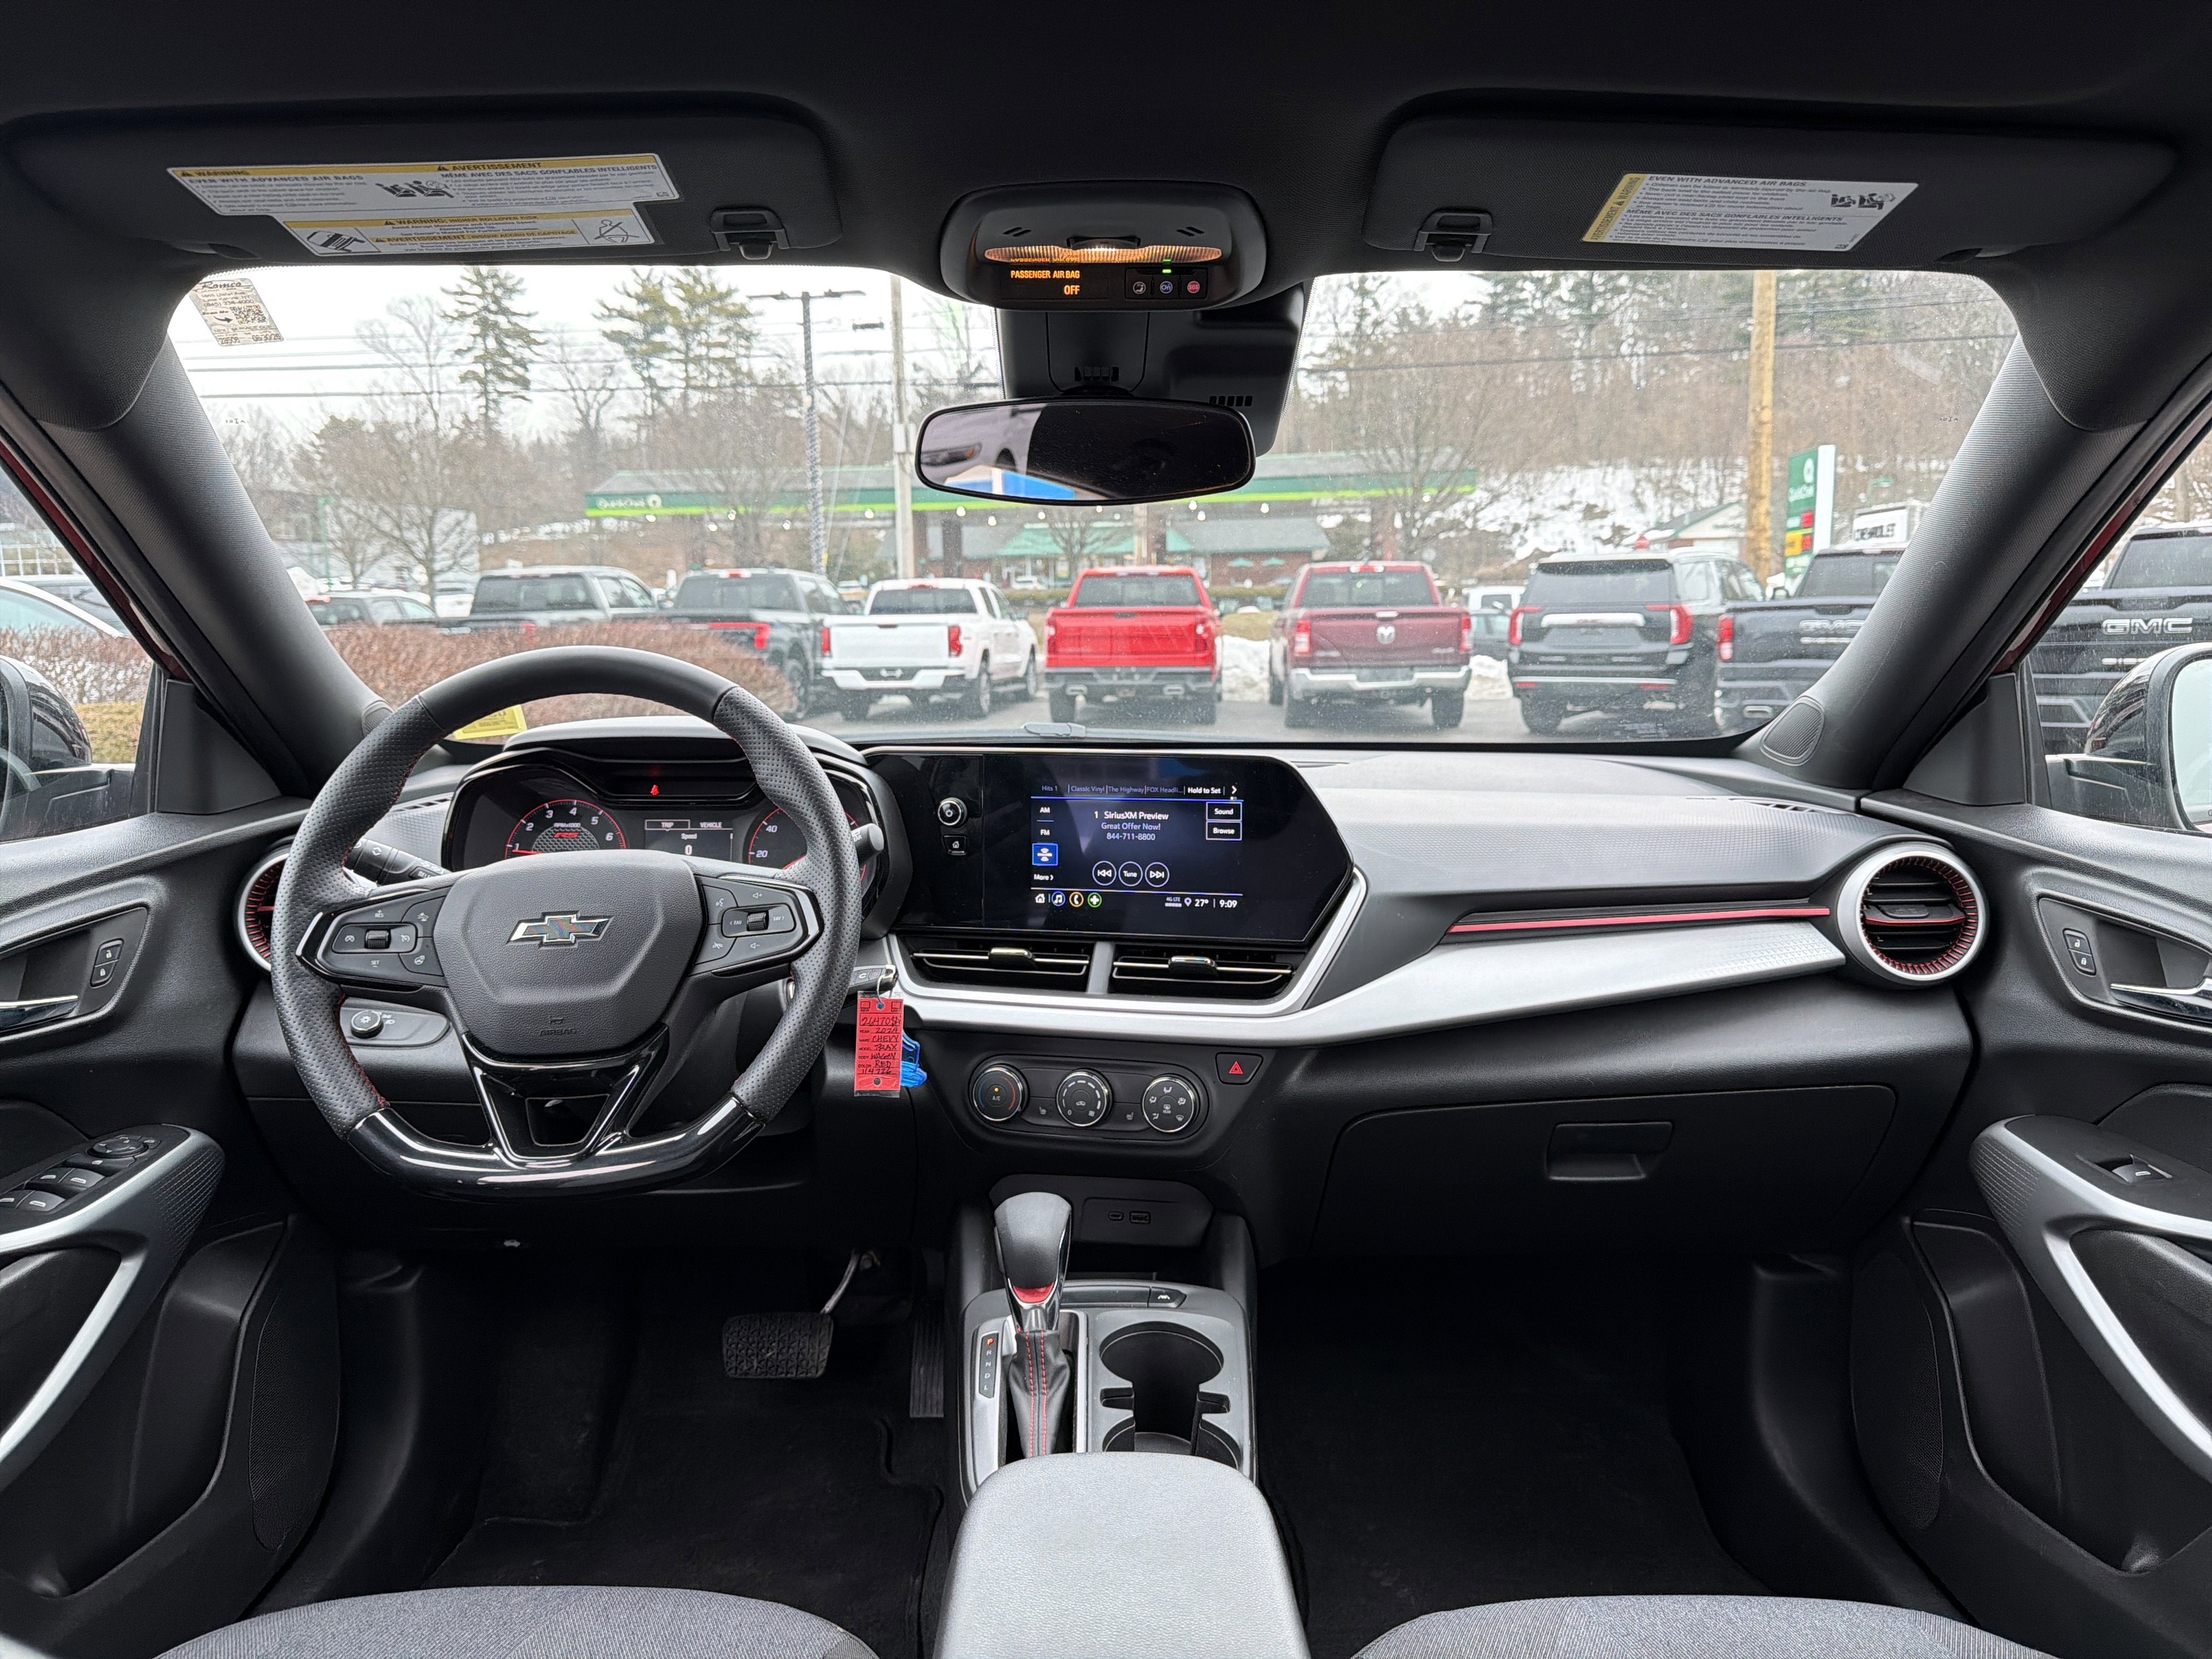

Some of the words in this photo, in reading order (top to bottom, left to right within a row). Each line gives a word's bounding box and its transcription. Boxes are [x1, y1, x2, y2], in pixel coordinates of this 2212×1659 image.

[453, 162, 541, 171] AVERTISSEMENT
[1616, 177, 1641, 200] WARNING
[1590, 206, 1621, 240] AVERTISSEMENT
[1011, 270, 1051, 279] PASSENGER
[1053, 270, 1065, 279] AIR
[1065, 270, 1080, 279] BAG
[1063, 285, 1080, 295] OFF
[2102, 617, 2193, 635] GMC
[545, 810, 554, 819] 3
[569, 807, 577, 816] 4
[1104, 811, 1137, 820] SiriusXM
[1138, 812, 1169, 820] Preview
[591, 816, 600, 825] 5
[525, 822, 534, 831] 2
[1122, 822, 1141, 831] Offer
[605, 832, 614, 841] 6
[685, 844, 692, 855] 0
[1219, 900, 1238, 909] 9:09
[875, 1060, 891, 1068] RED
